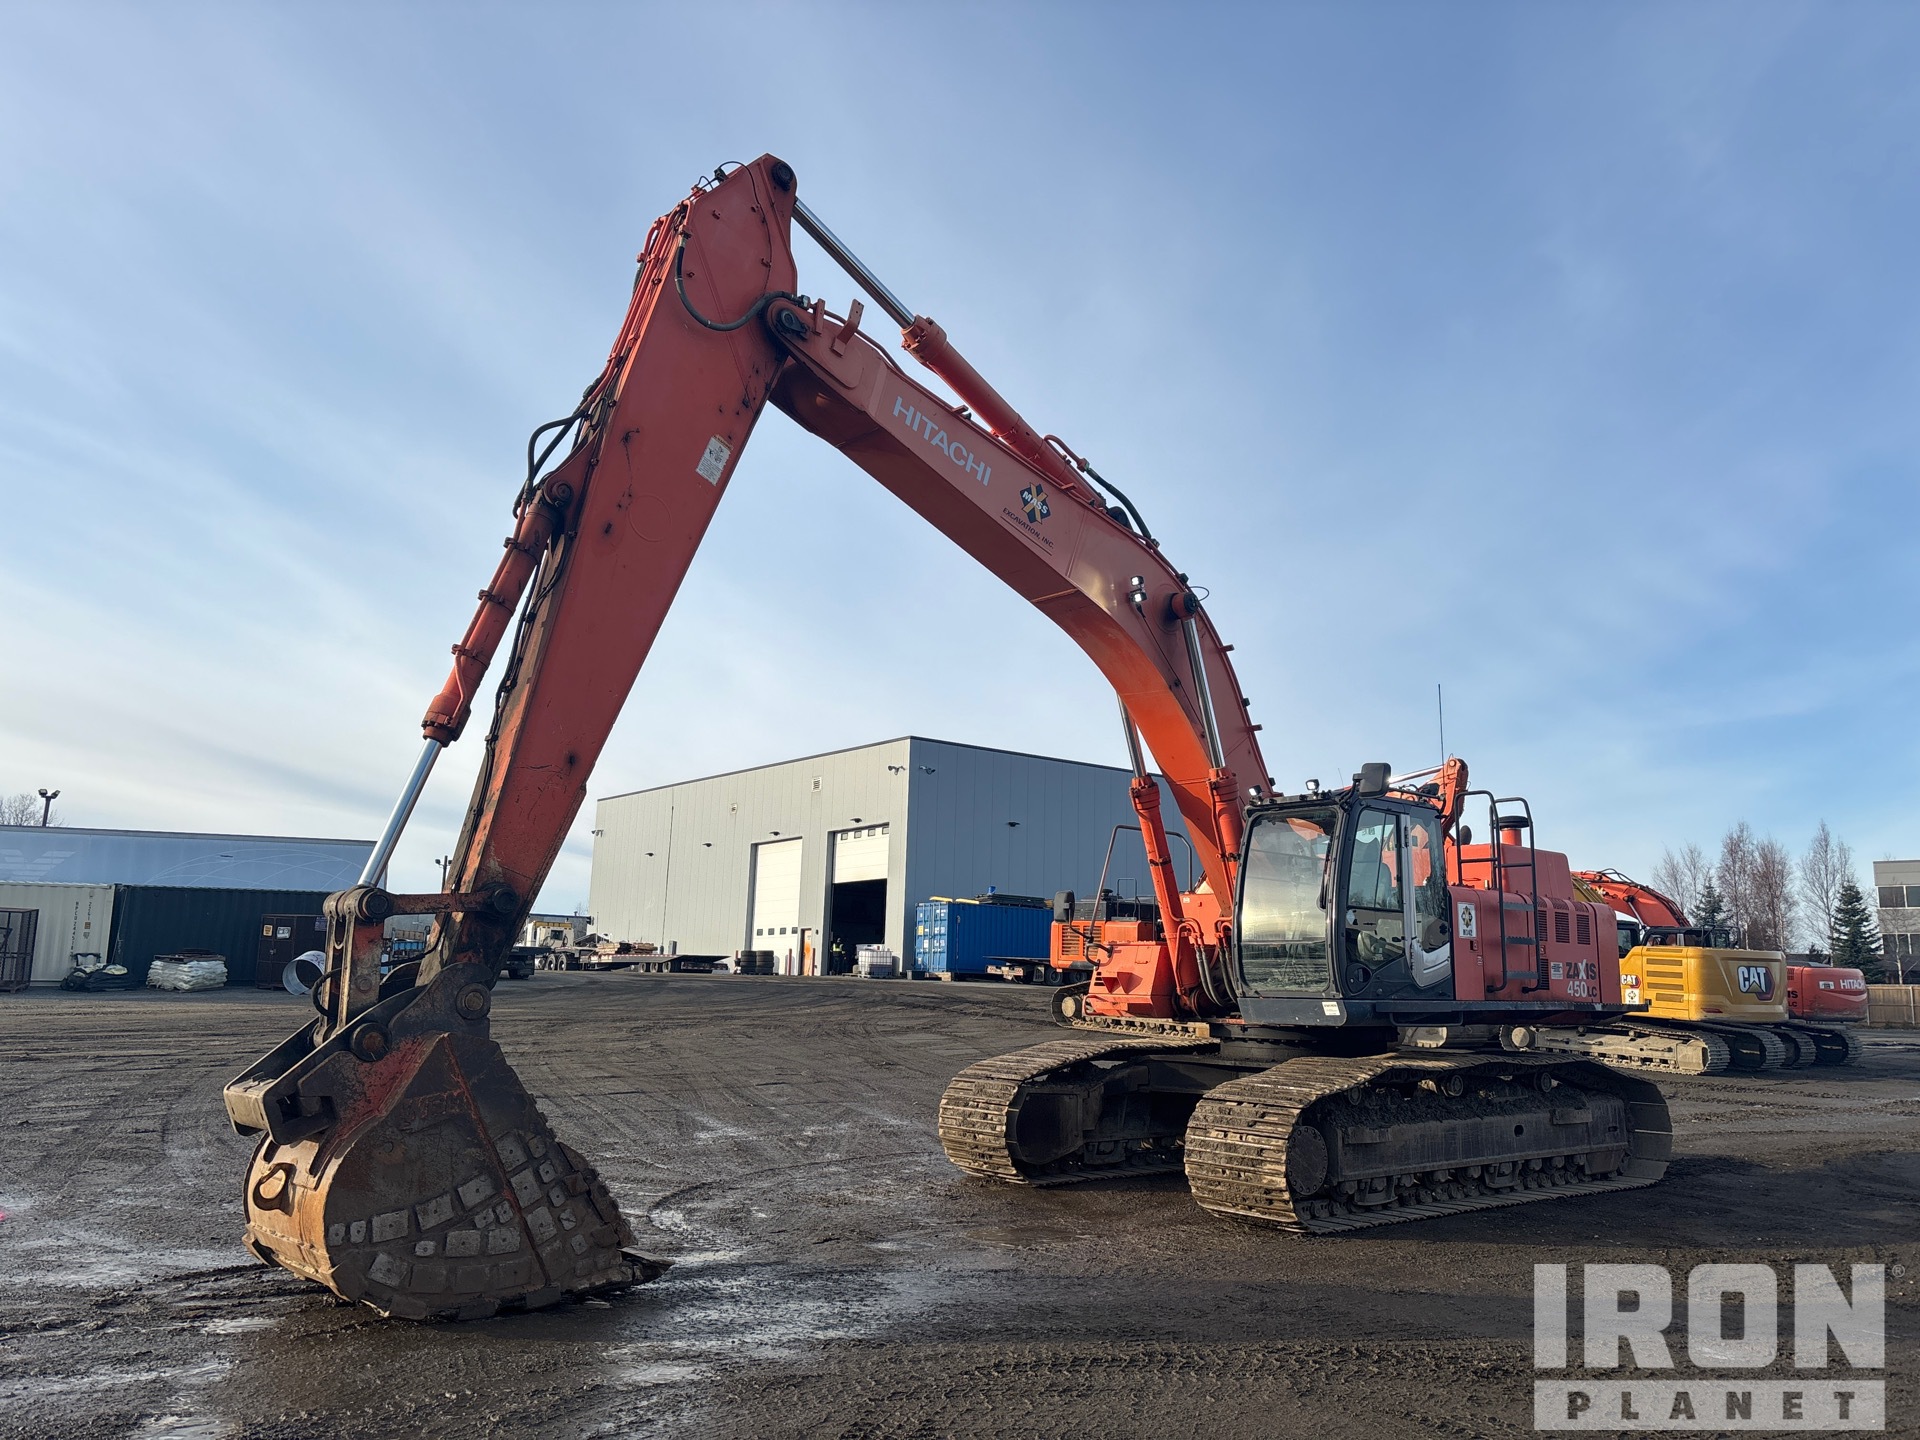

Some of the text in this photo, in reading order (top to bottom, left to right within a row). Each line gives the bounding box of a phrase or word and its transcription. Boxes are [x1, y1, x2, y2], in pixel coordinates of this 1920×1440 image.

[892, 396, 992, 487] HITACHI
[1022, 491, 1049, 514] MASS
[1002, 507, 1054, 550] EXCAVATION, INC.
[1566, 959, 1597, 980] ZAXIS
[1621, 974, 1637, 986] CAT
[1738, 966, 1766, 993] CAT
